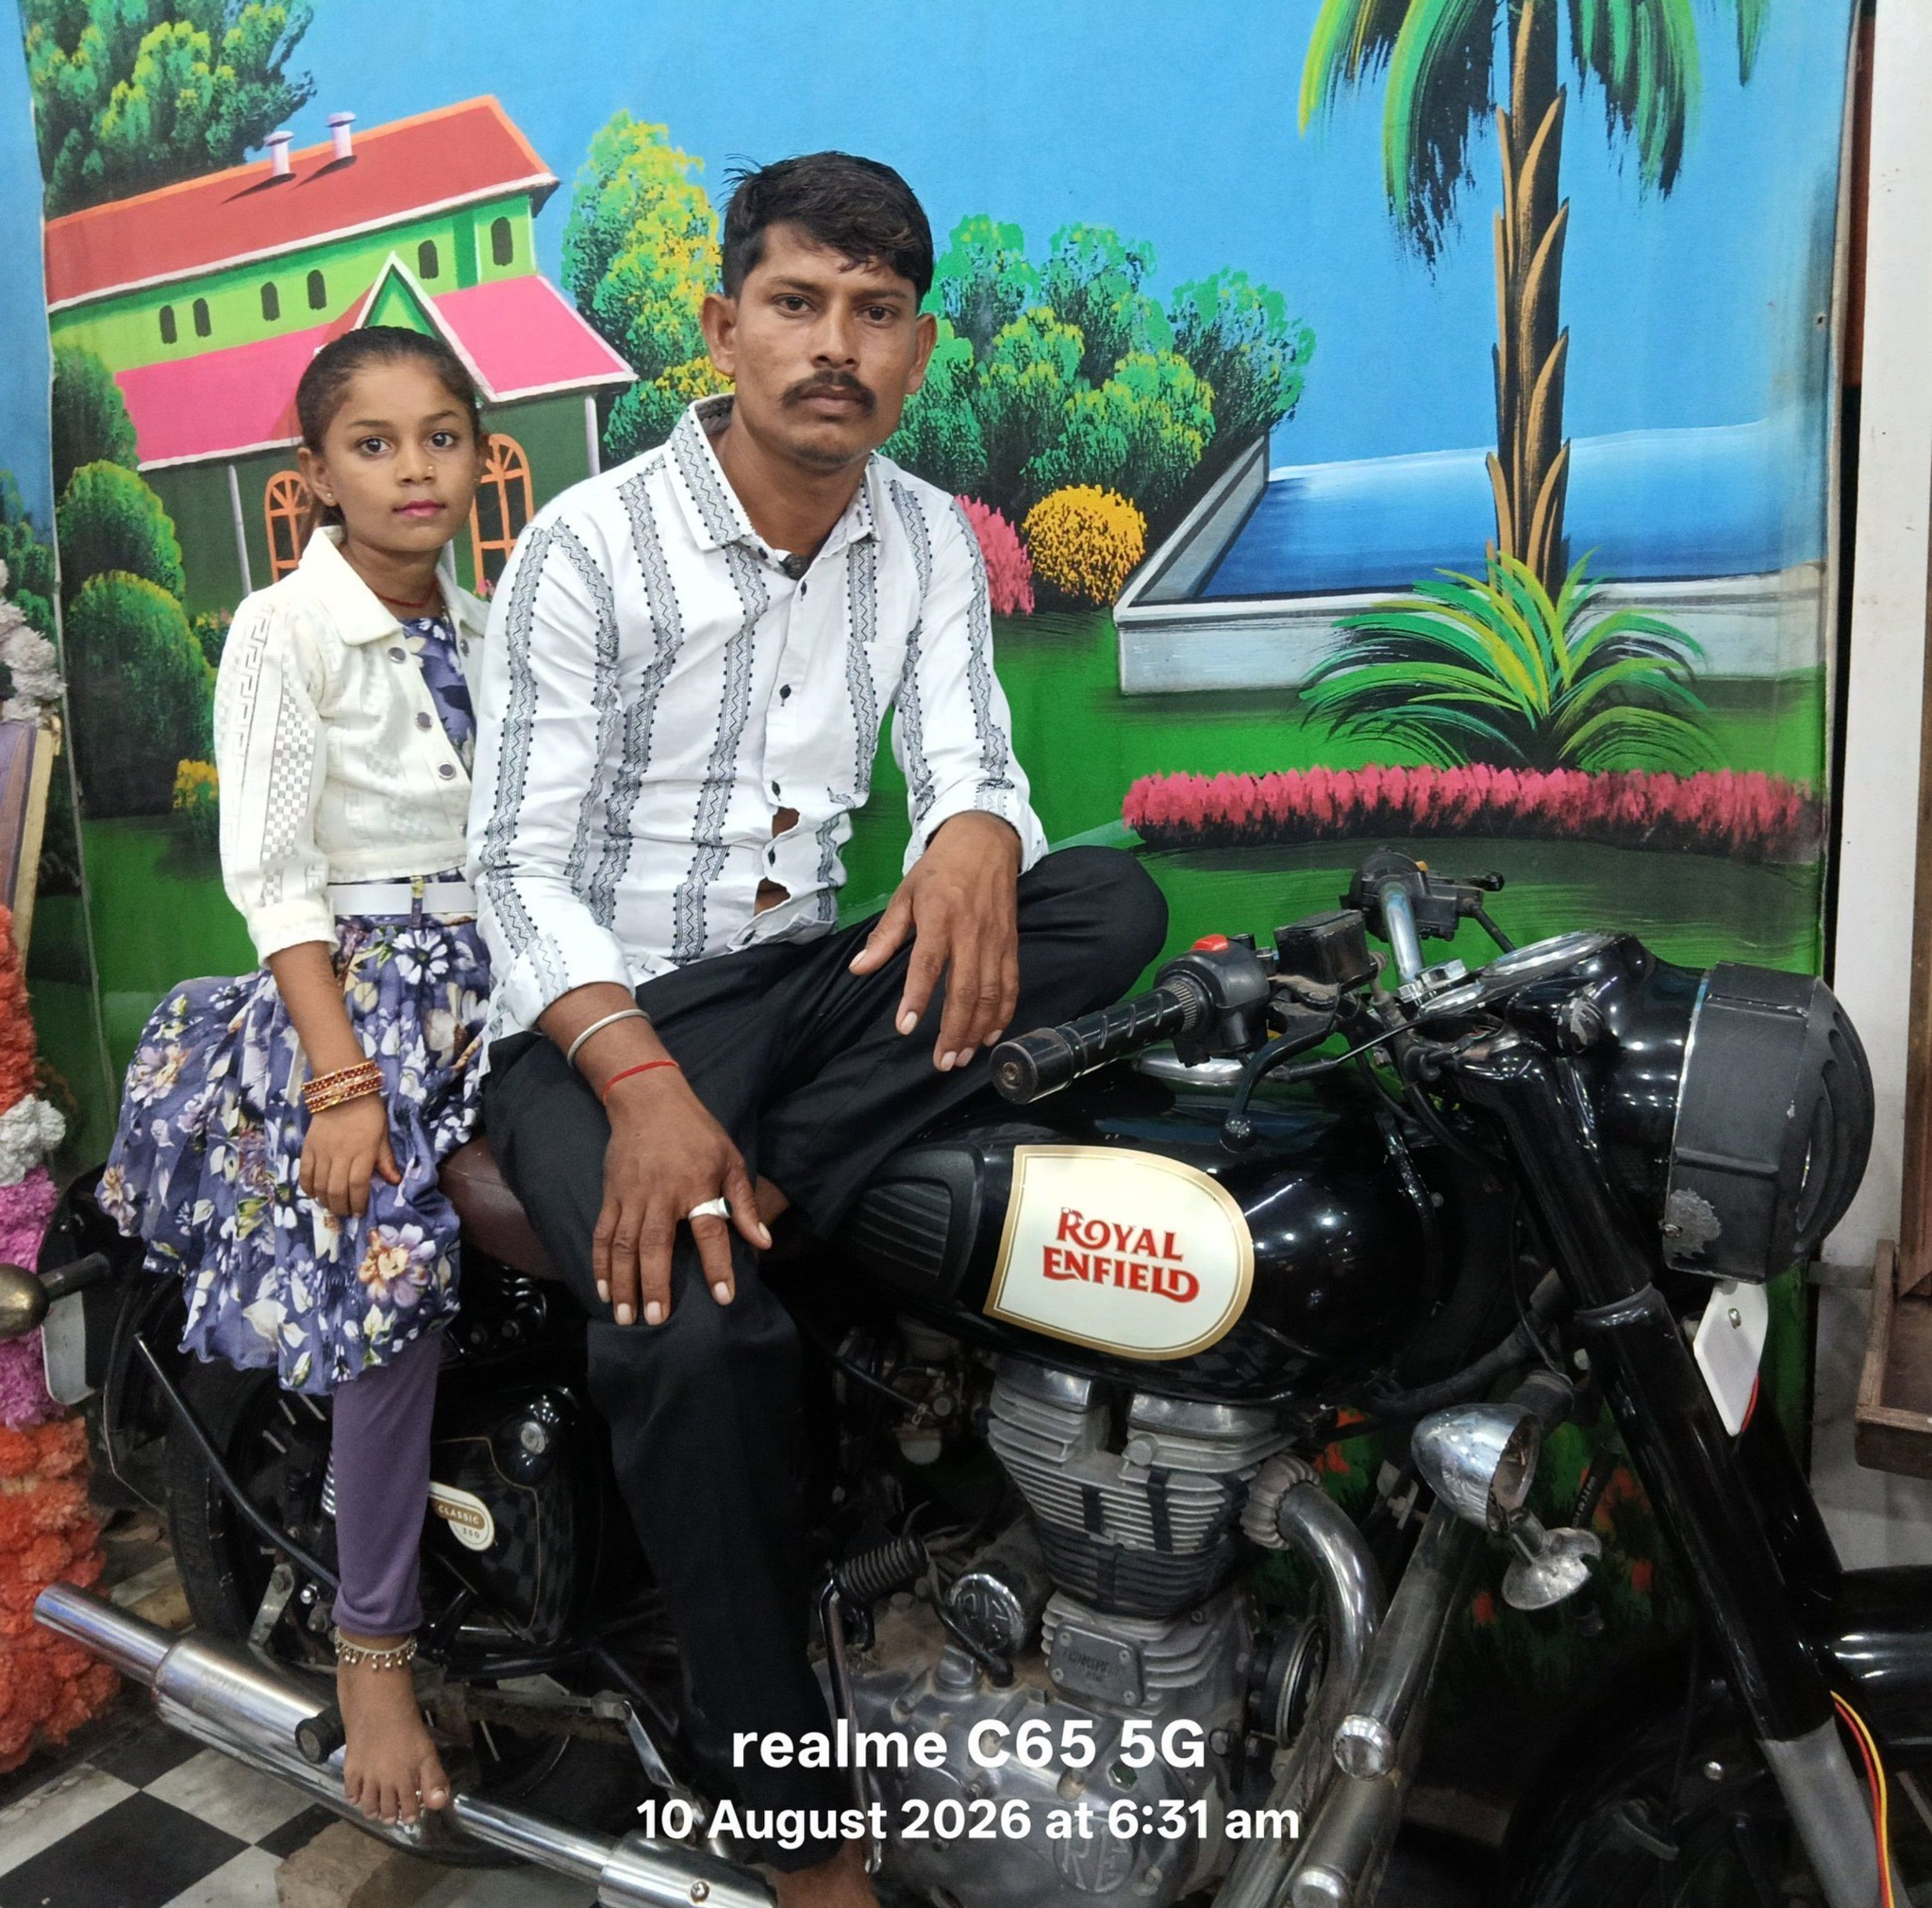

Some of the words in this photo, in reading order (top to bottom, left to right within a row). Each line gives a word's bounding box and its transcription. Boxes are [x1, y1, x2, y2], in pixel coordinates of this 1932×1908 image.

[1056, 1206, 1184, 1262] ROYAL
[1041, 1245, 1200, 1303] ENFIELD
[439, 1506, 478, 1524] CLASSIC
